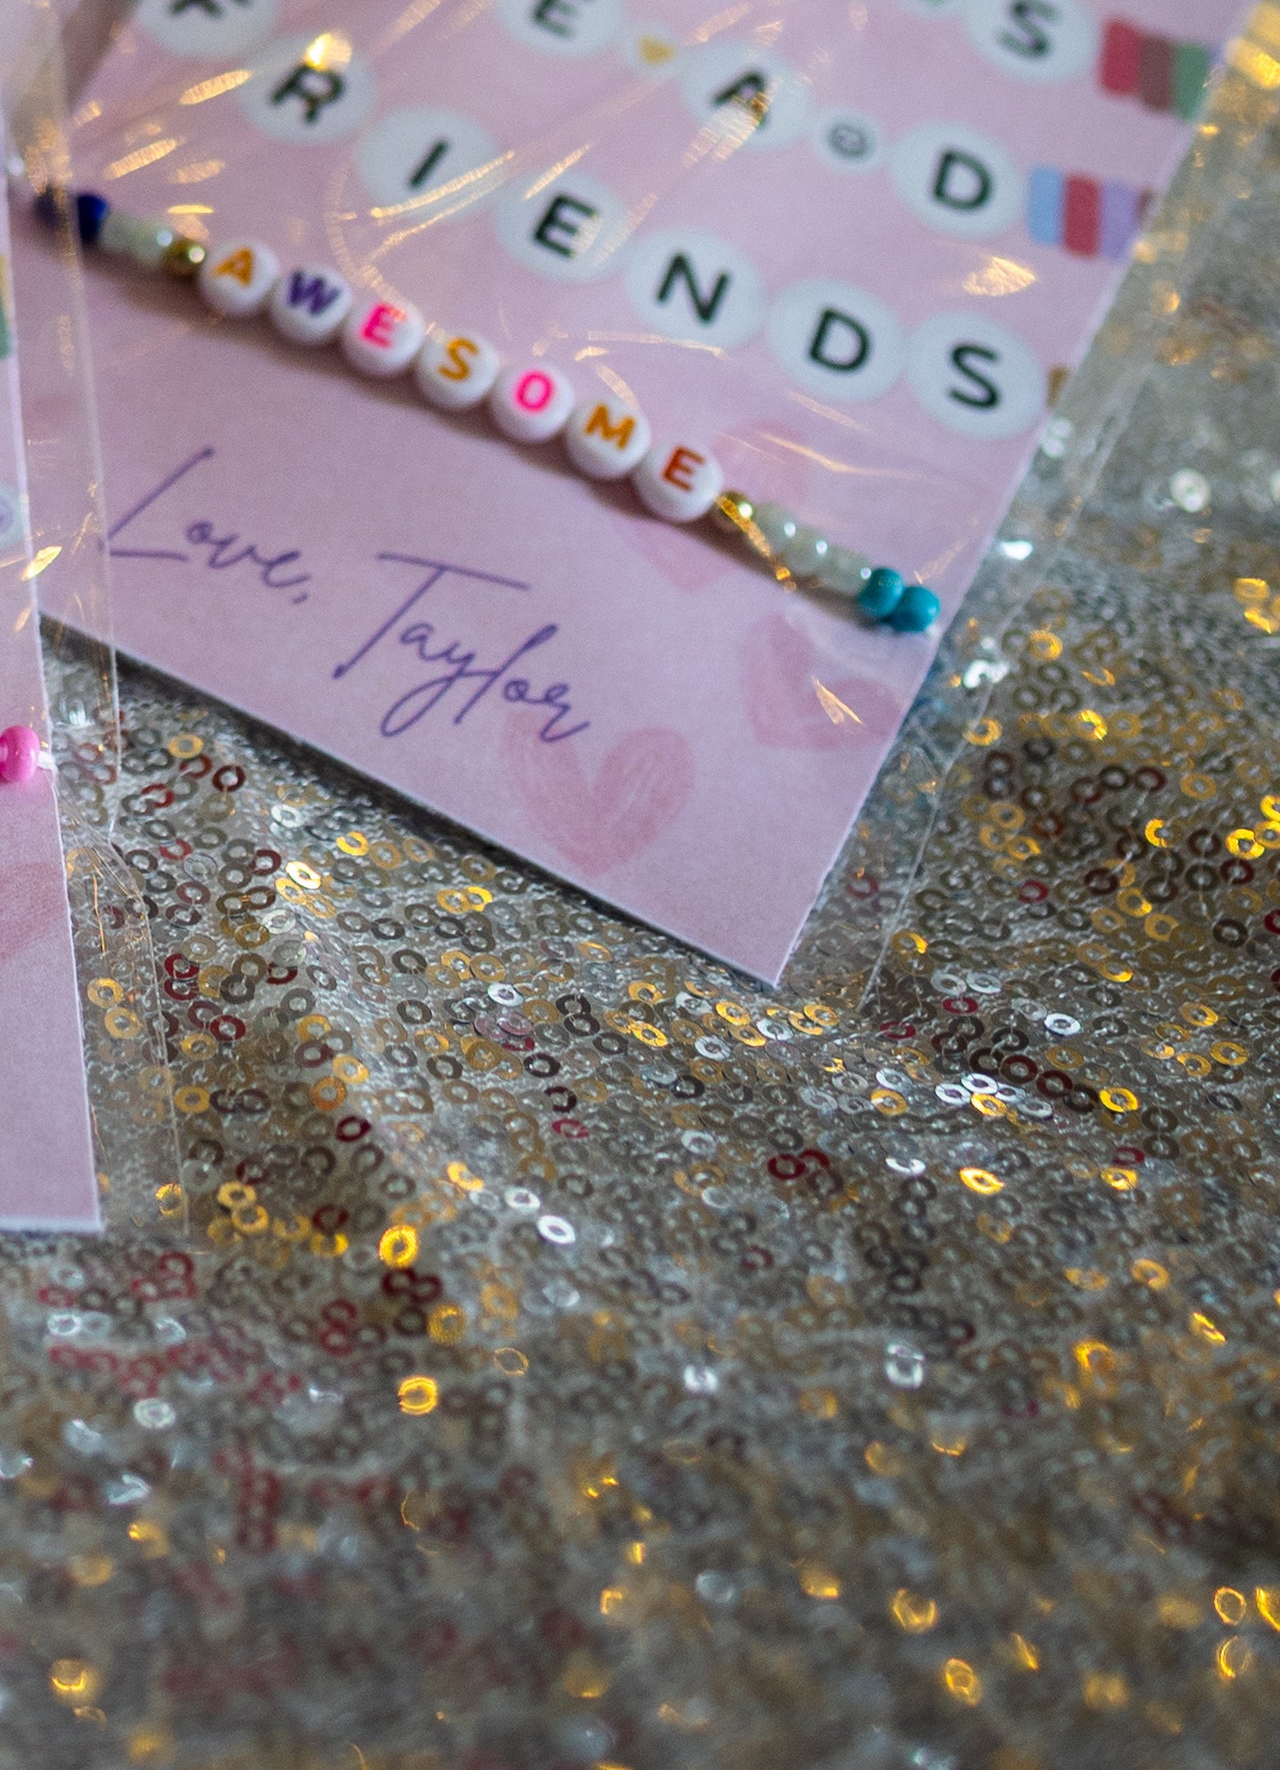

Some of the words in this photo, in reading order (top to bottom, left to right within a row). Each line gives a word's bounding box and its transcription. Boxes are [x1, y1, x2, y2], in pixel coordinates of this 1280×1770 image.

[213, 246, 705, 494] AWESOME
[99, 447, 311, 605] Love,
[330, 550, 591, 745] Taylor
